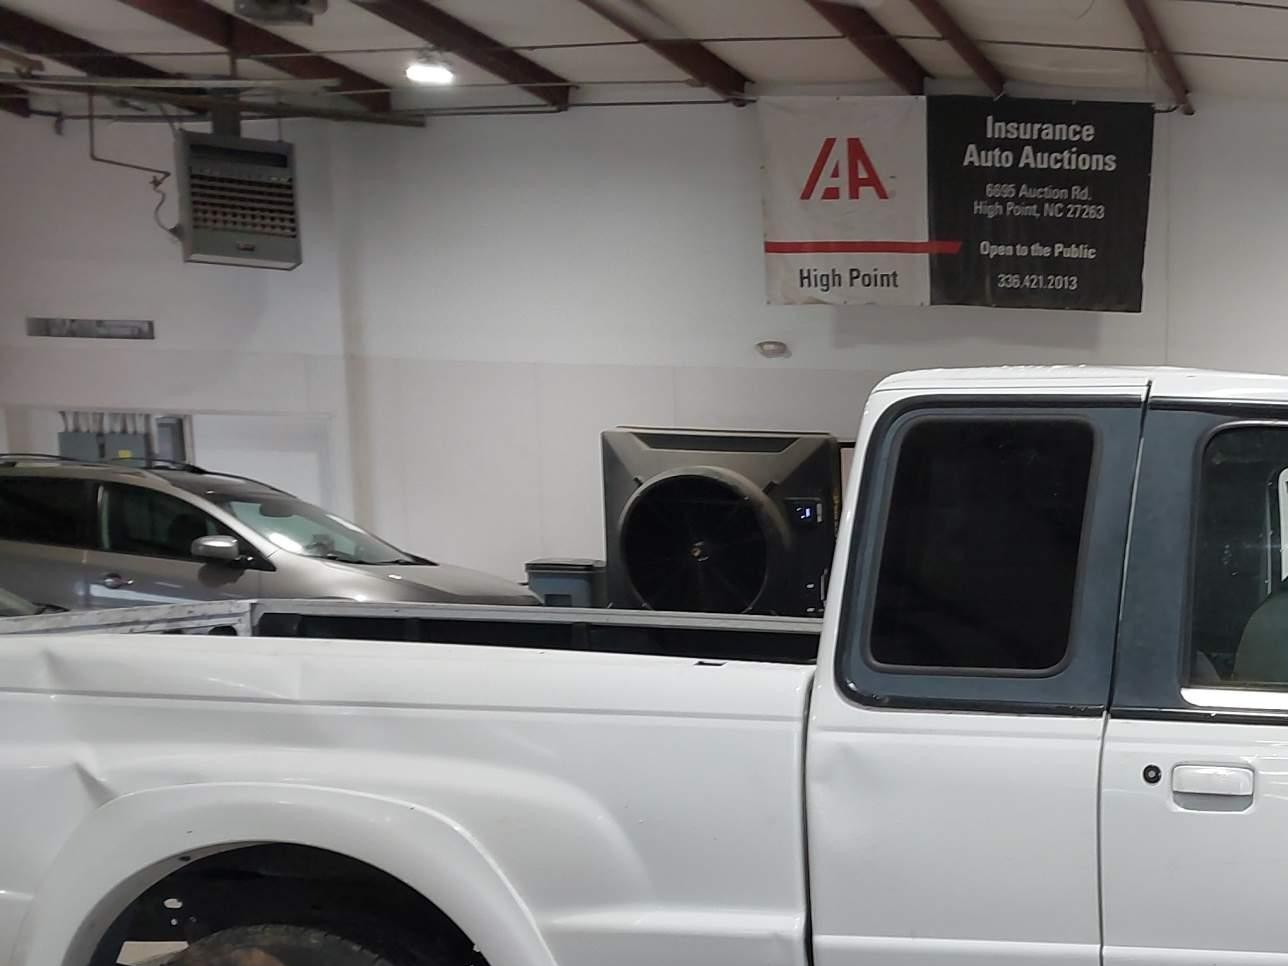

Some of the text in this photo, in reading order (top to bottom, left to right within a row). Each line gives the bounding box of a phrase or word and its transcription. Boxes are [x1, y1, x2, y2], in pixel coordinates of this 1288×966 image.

[986, 115, 1095, 142] Insurance
[963, 143, 1117, 171] Auto Auctions
[1018, 184, 1069, 200] Auction
[1071, 185, 1092, 201] Rd.
[973, 200, 1105, 219] High Point, NC 27263
[980, 240, 1097, 259] Open to the Public
[799, 267, 899, 292] High Point
[997, 273, 1078, 290] 336.421.2013
